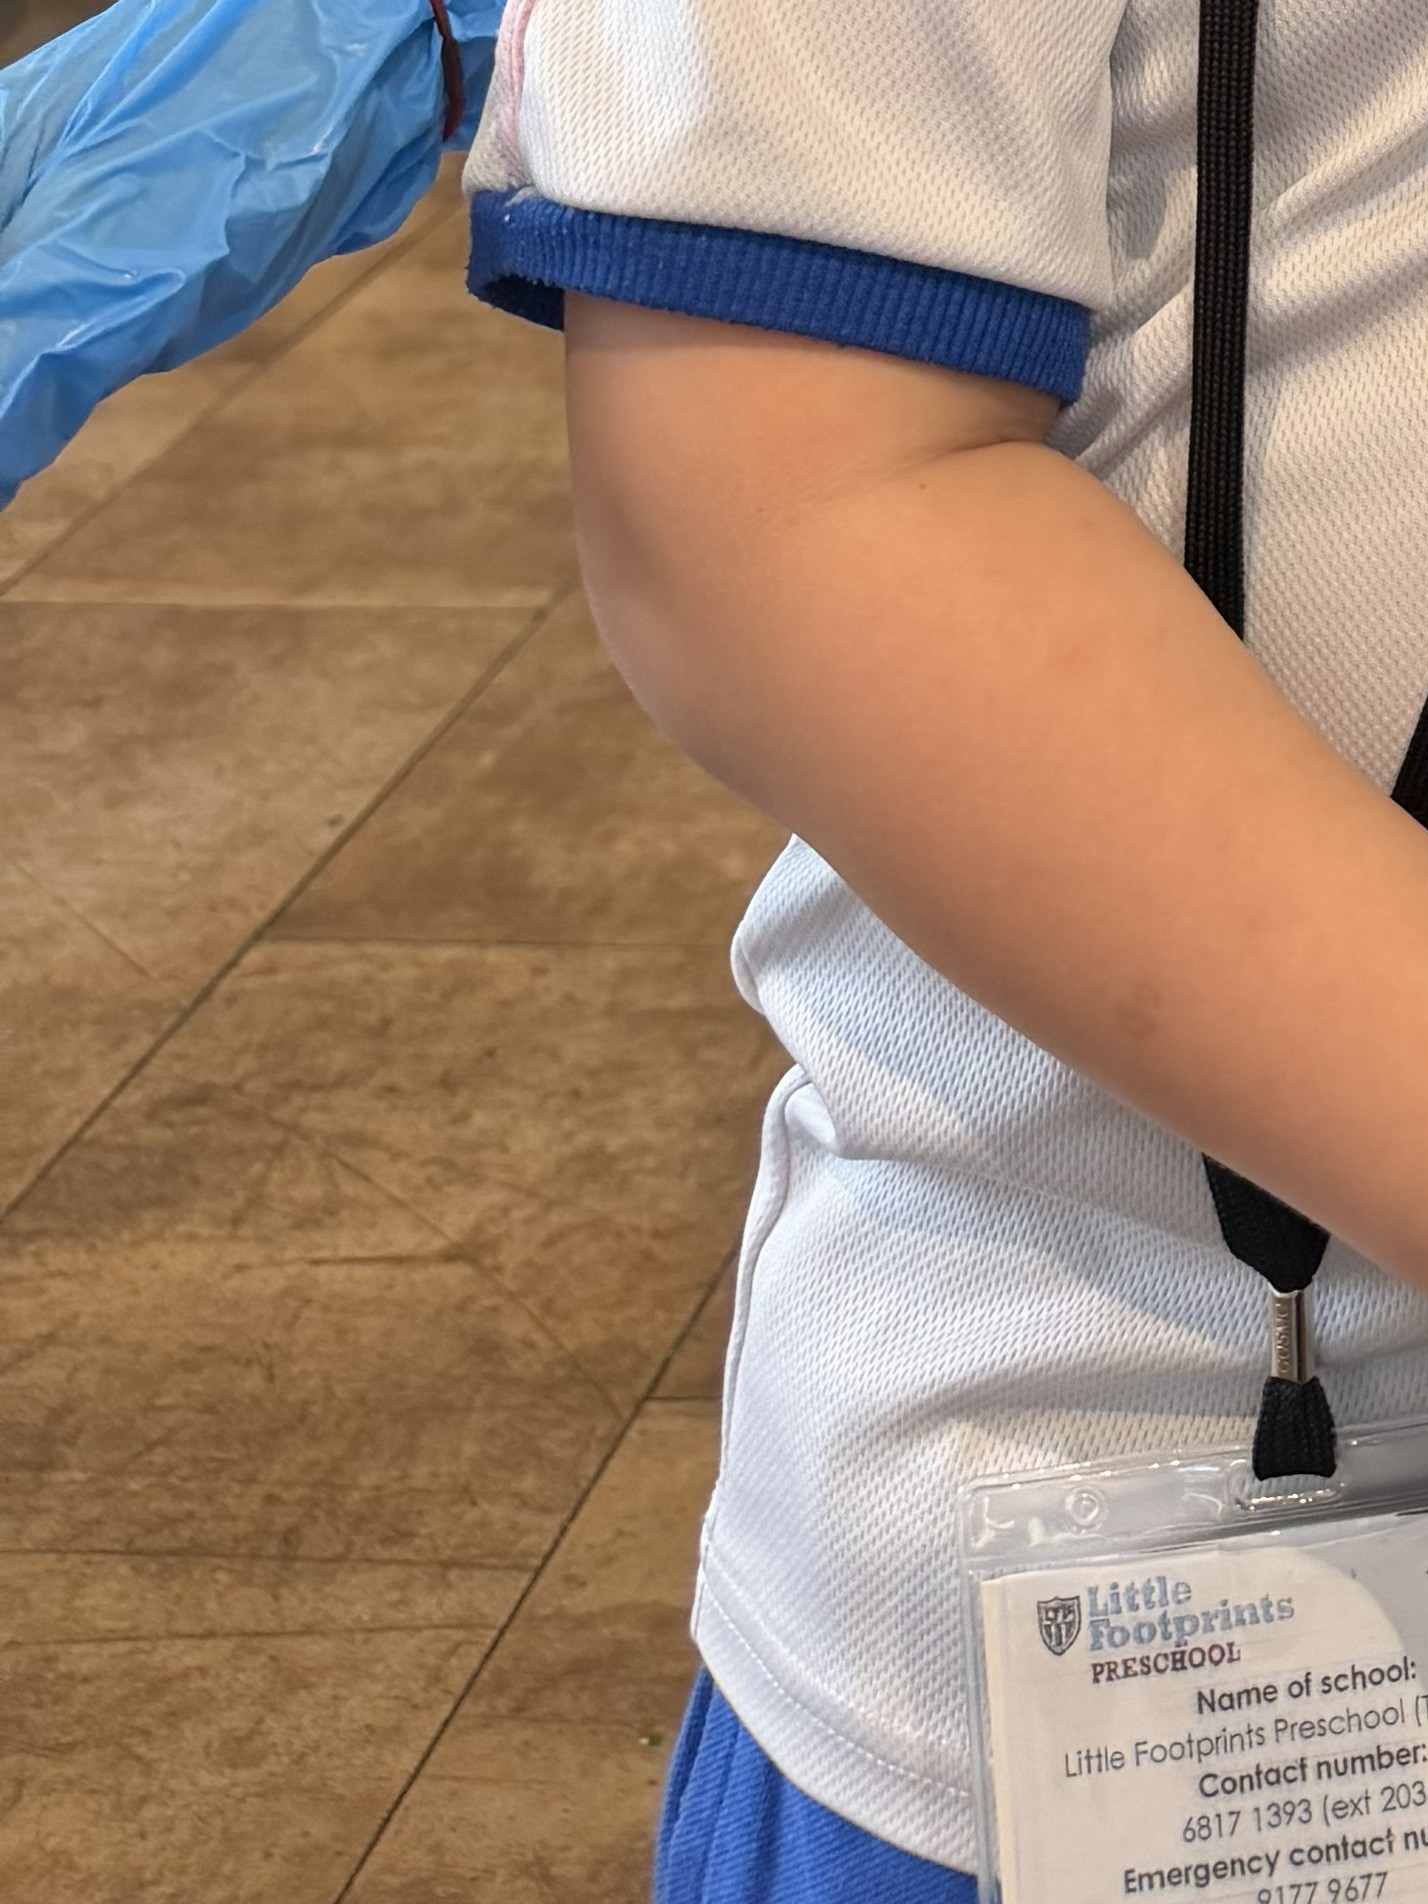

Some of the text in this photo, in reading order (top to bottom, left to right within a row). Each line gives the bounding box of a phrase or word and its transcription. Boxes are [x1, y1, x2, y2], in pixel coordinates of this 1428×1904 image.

[1084, 1572, 1193, 1619] Little
[1087, 1591, 1297, 1654] Footprints
[1090, 1640, 1243, 1685] PRESCHOOL
[1195, 1655, 1418, 1716] Name of school:
[1063, 1744, 1126, 1779] Little
[1132, 1722, 1268, 1772] Footprints
[1273, 1698, 1407, 1744] Preschool
[1197, 1739, 1428, 1800] Contact number:
[1179, 1809, 1244, 1844] 6817
[1252, 1798, 1314, 1832] 1393
[1320, 1787, 1374, 1826] (ext
[1122, 1846, 1285, 1898] Emergency
[1287, 1826, 1397, 1869] contact
[1256, 1871, 1391, 1904] 9177 9677
